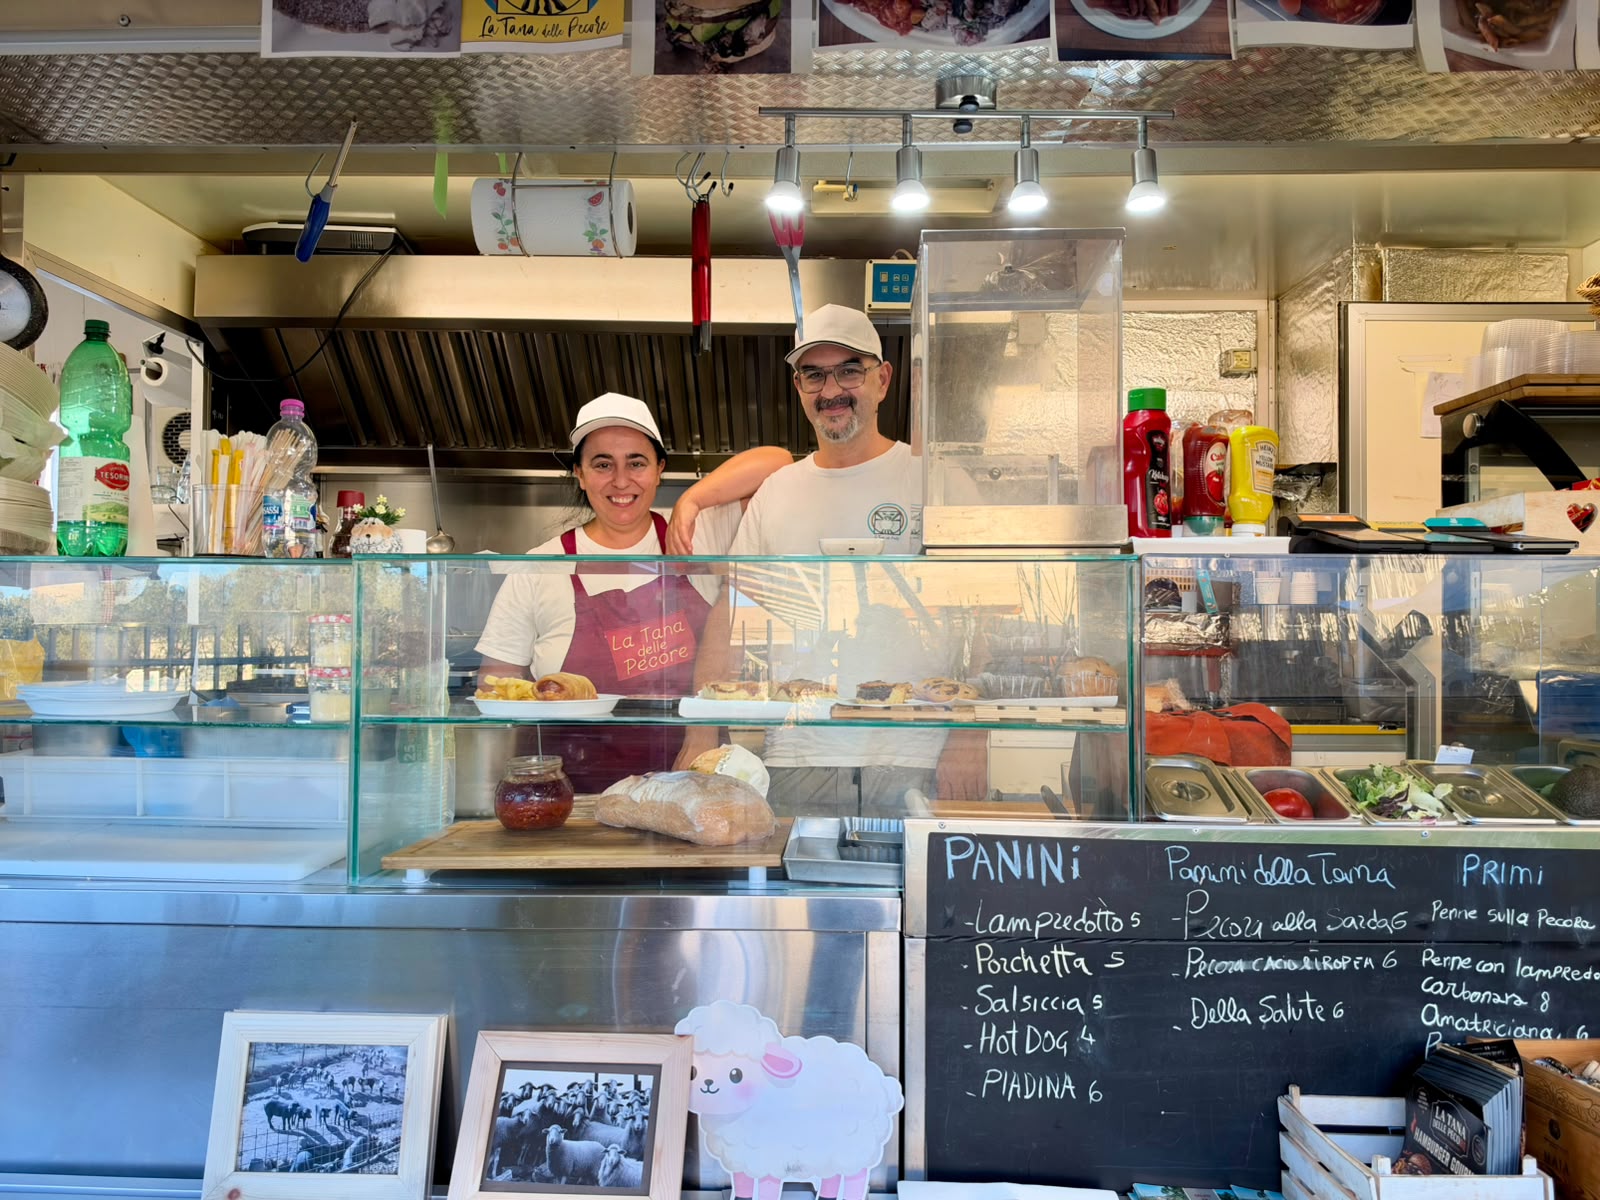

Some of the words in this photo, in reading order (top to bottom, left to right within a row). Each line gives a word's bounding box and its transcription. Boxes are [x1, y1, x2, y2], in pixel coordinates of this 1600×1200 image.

[479, 15, 499, 38] La
[496, 16, 539, 36] Tana
[541, 24, 565, 38] delle
[568, 15, 610, 38] Pecore
[612, 635, 636, 652] La
[640, 621, 686, 643] Tana
[637, 641, 668, 657] delle
[623, 646, 689, 675] Pecore
[1253, 853, 1316, 886] della
[1130, 912, 1142, 928] 5
[1272, 910, 1317, 933] alla
[1431, 899, 1478, 922] Penne
[975, 943, 1092, 977] Porchetta
[1104, 951, 1125, 969] 5
[1382, 950, 1398, 970] 6
[1475, 960, 1506, 974] con
[975, 985, 1085, 1016] Salsiccia
[1091, 994, 1104, 1011] 5
[1190, 996, 1252, 1030] Della
[1258, 991, 1326, 1024] Salute
[1332, 1001, 1345, 1019] 6
[1080, 1024, 1096, 1046] 4
[982, 1068, 1077, 1102] PIADINA
[1088, 1079, 1104, 1104] 6
[1432, 1118, 1447, 1135] DELLE
[1434, 1105, 1446, 1124] LA
[1447, 1112, 1466, 1140] TANA
[1413, 1126, 1451, 1168] HAMBURGER
